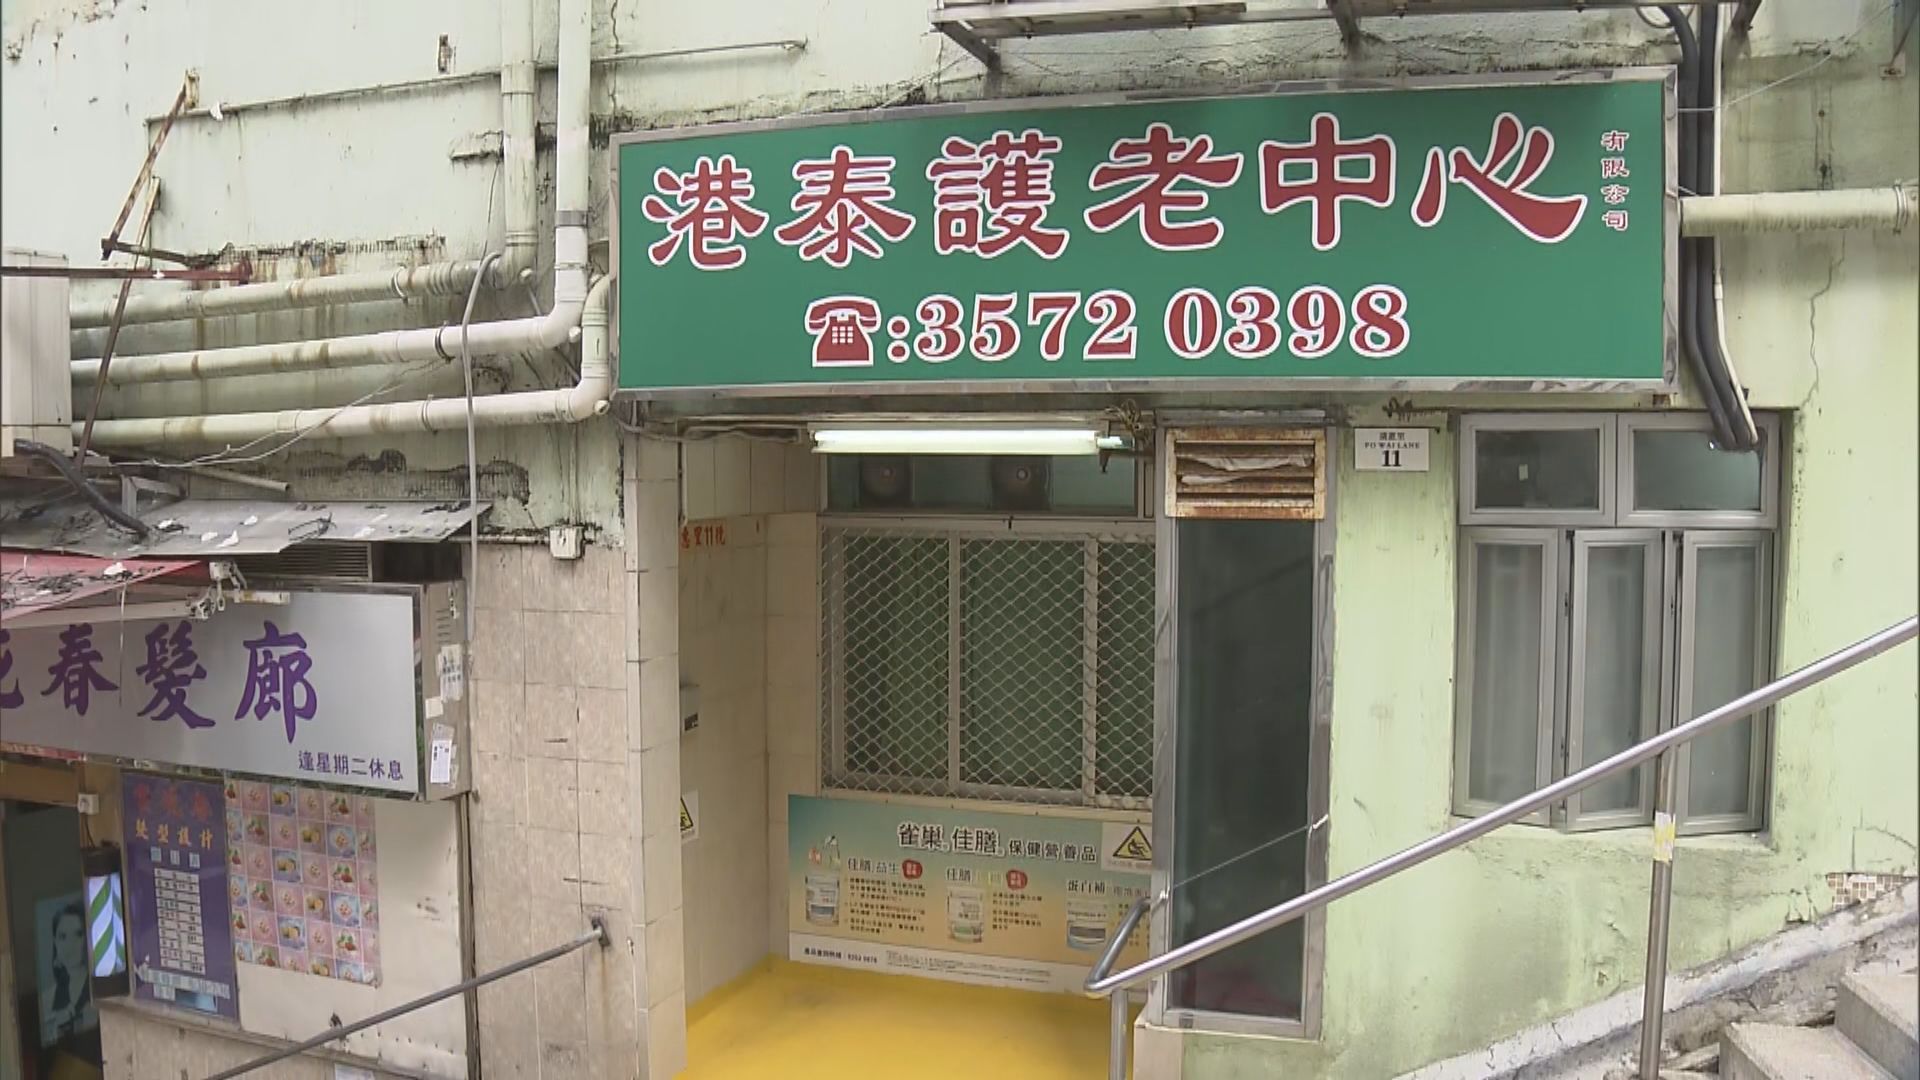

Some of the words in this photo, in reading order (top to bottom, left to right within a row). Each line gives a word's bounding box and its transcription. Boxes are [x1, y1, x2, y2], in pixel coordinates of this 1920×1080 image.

[641, 112, 1588, 270] 港泰護老中心
[1600, 129, 1631, 232] 有限公司
[1163, 284, 1411, 359] 0398
[1364, 441, 1377, 449] PO
[1378, 441, 1396, 449] WAI
[1396, 441, 1421, 449] LANE
[1381, 449, 1402, 467] 11
[298, 750, 404, 781] 逢星期二休息
[1008, 839, 1097, 863] 保健營養品
